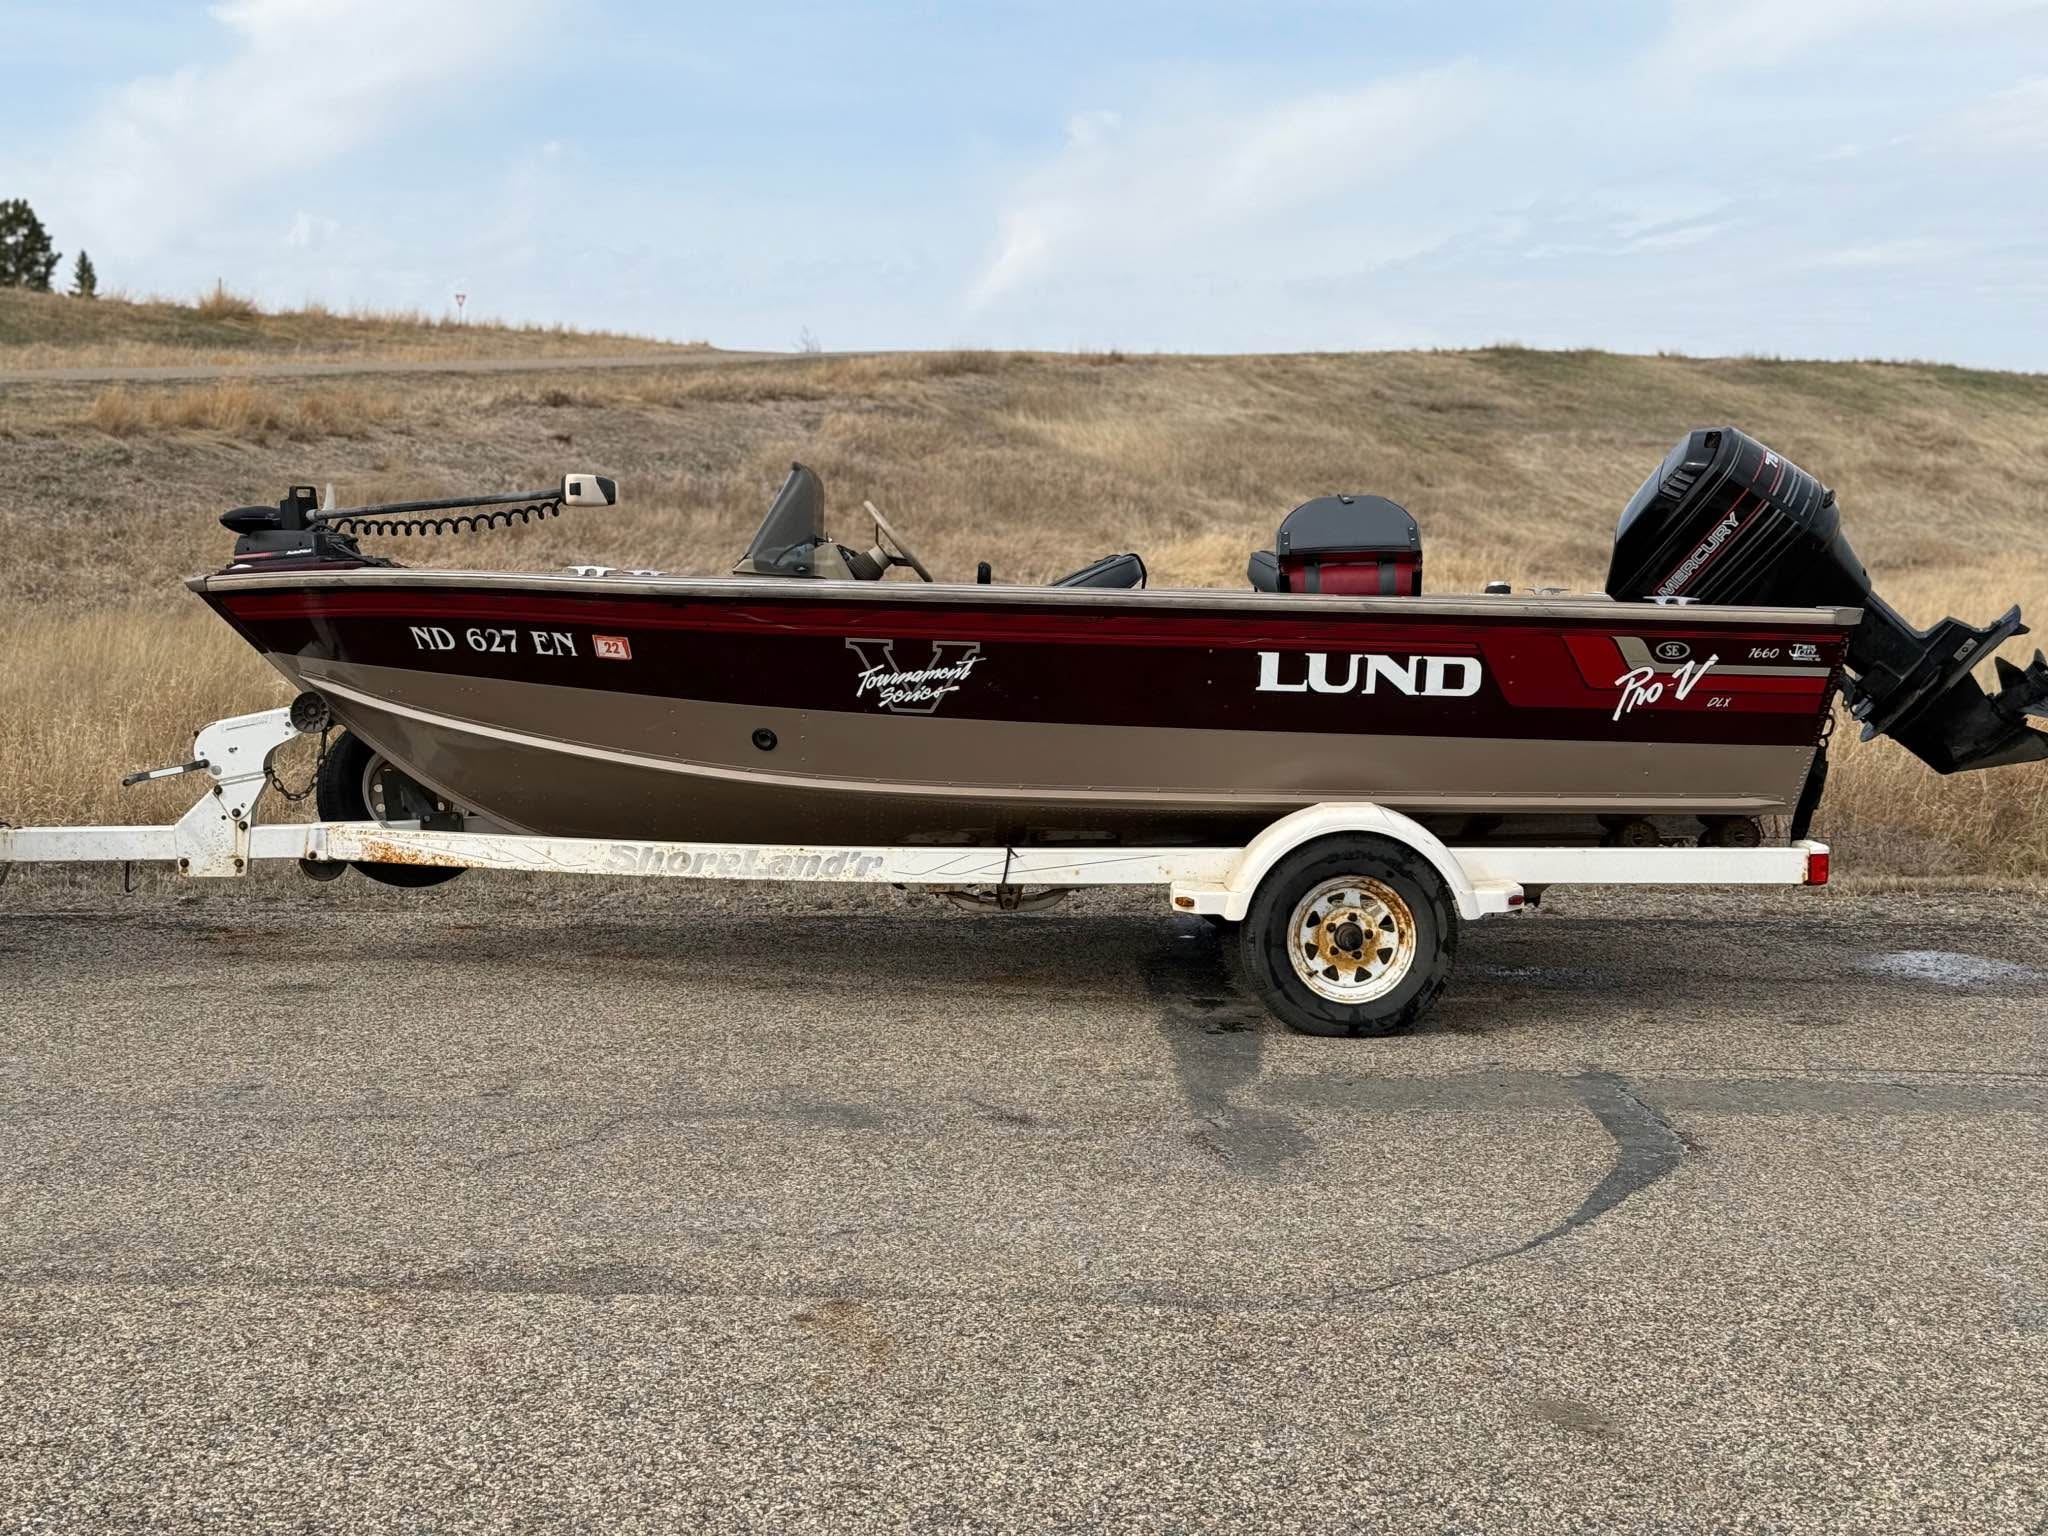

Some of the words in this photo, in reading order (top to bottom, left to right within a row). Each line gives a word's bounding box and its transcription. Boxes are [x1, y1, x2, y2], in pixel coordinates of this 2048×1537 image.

[1658, 511, 1739, 597] MERCURY
[409, 627, 456, 650] ND
[466, 628, 517, 652] 627
[530, 631, 578, 656] EN
[603, 641, 621, 655] 22
[1665, 645, 1680, 656] SE
[1748, 648, 1779, 659] 1660
[856, 656, 987, 697] Tournament
[1256, 652, 1483, 697] LUND
[878, 685, 960, 707] Series
[1707, 697, 1732, 707] DLX
[604, 845, 883, 877] ShoreLand'r
